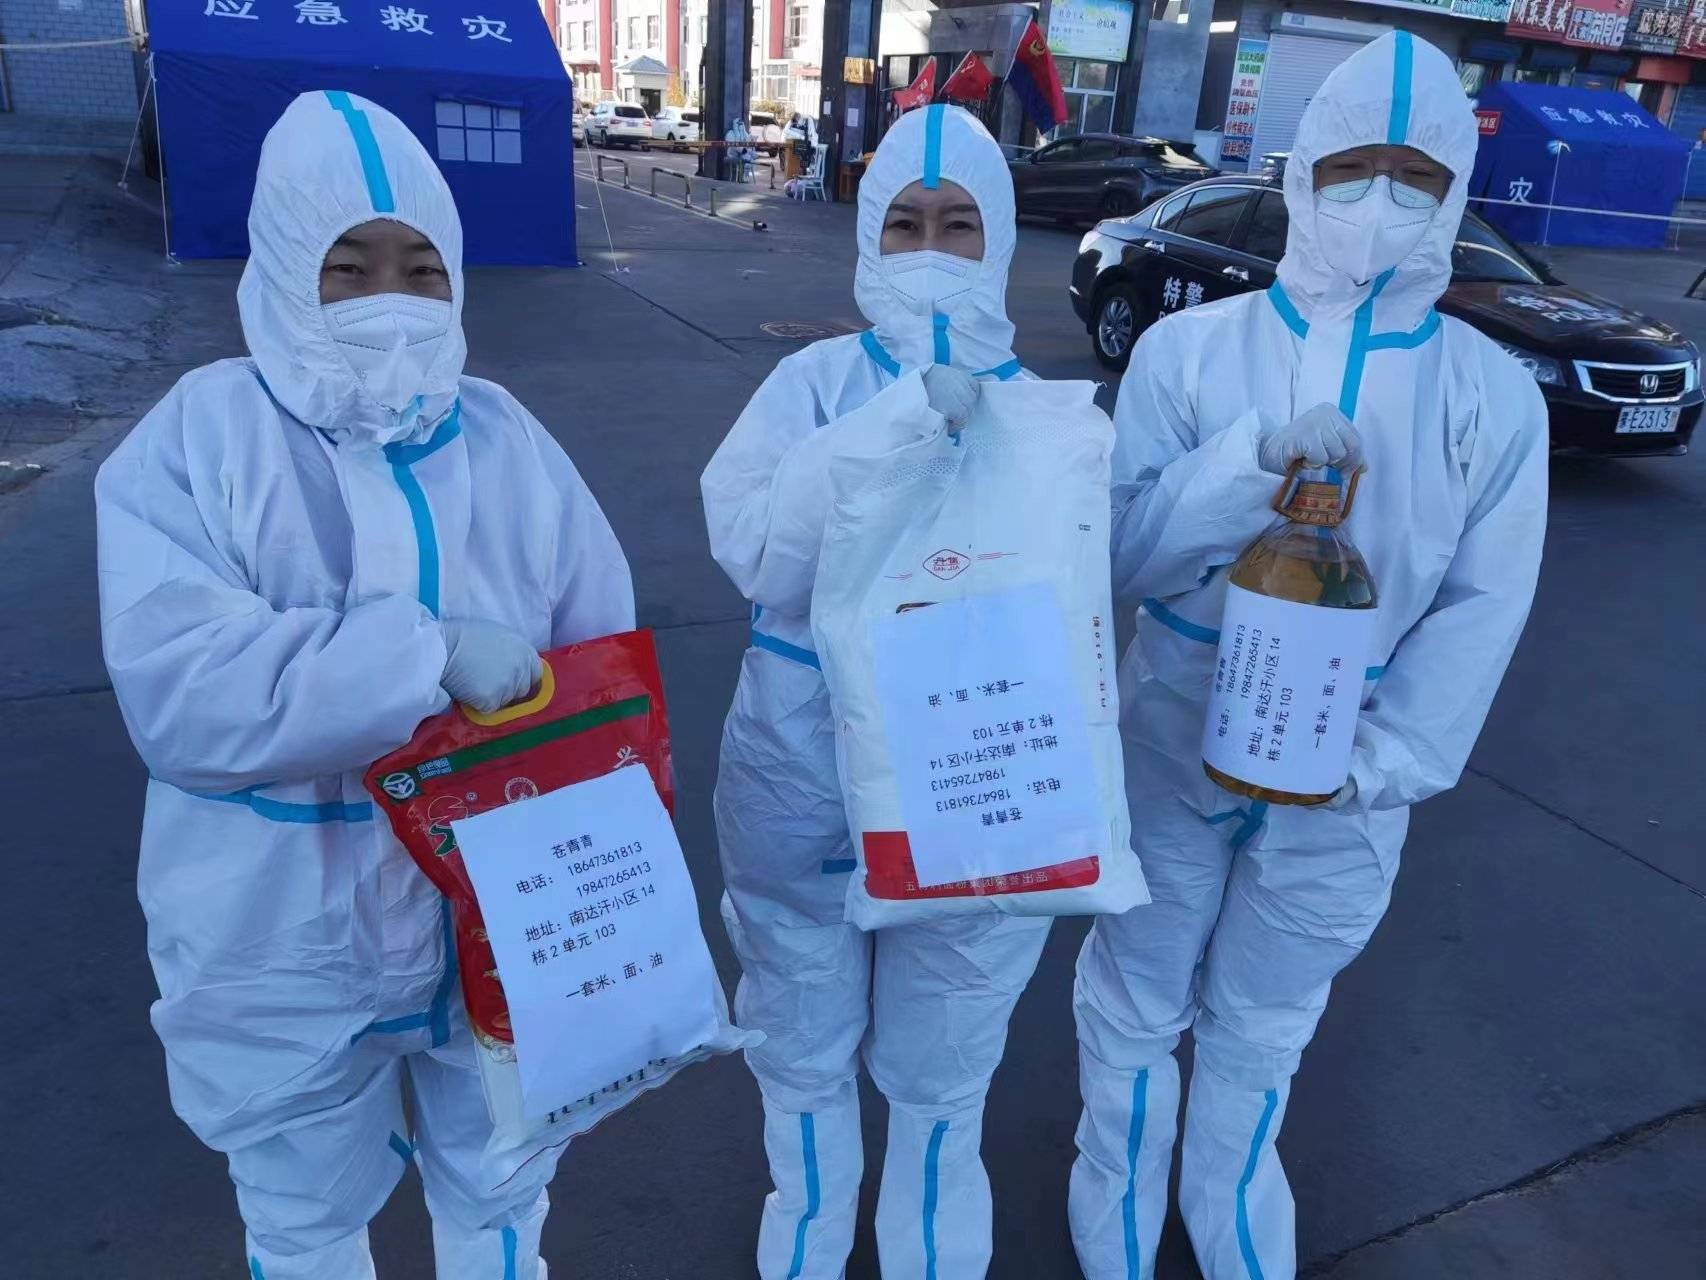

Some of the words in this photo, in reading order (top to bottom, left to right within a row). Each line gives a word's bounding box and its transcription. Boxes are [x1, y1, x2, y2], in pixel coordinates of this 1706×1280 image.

[1509, 177, 1534, 204] 灾
[1163, 276, 1205, 309] 特警
[1226, 624, 1246, 694] 18647361813
[1241, 628, 1263, 700] 19847265413
[930, 767, 1006, 792] 19847265413
[935, 788, 1012, 812] 18647361813
[981, 807, 1024, 827] 苍青青
[552, 834, 594, 860] 苍青青
[516, 873, 554, 895] 电话：
[567, 841, 643, 876] 18647361813
[576, 861, 652, 898] 19847265413
